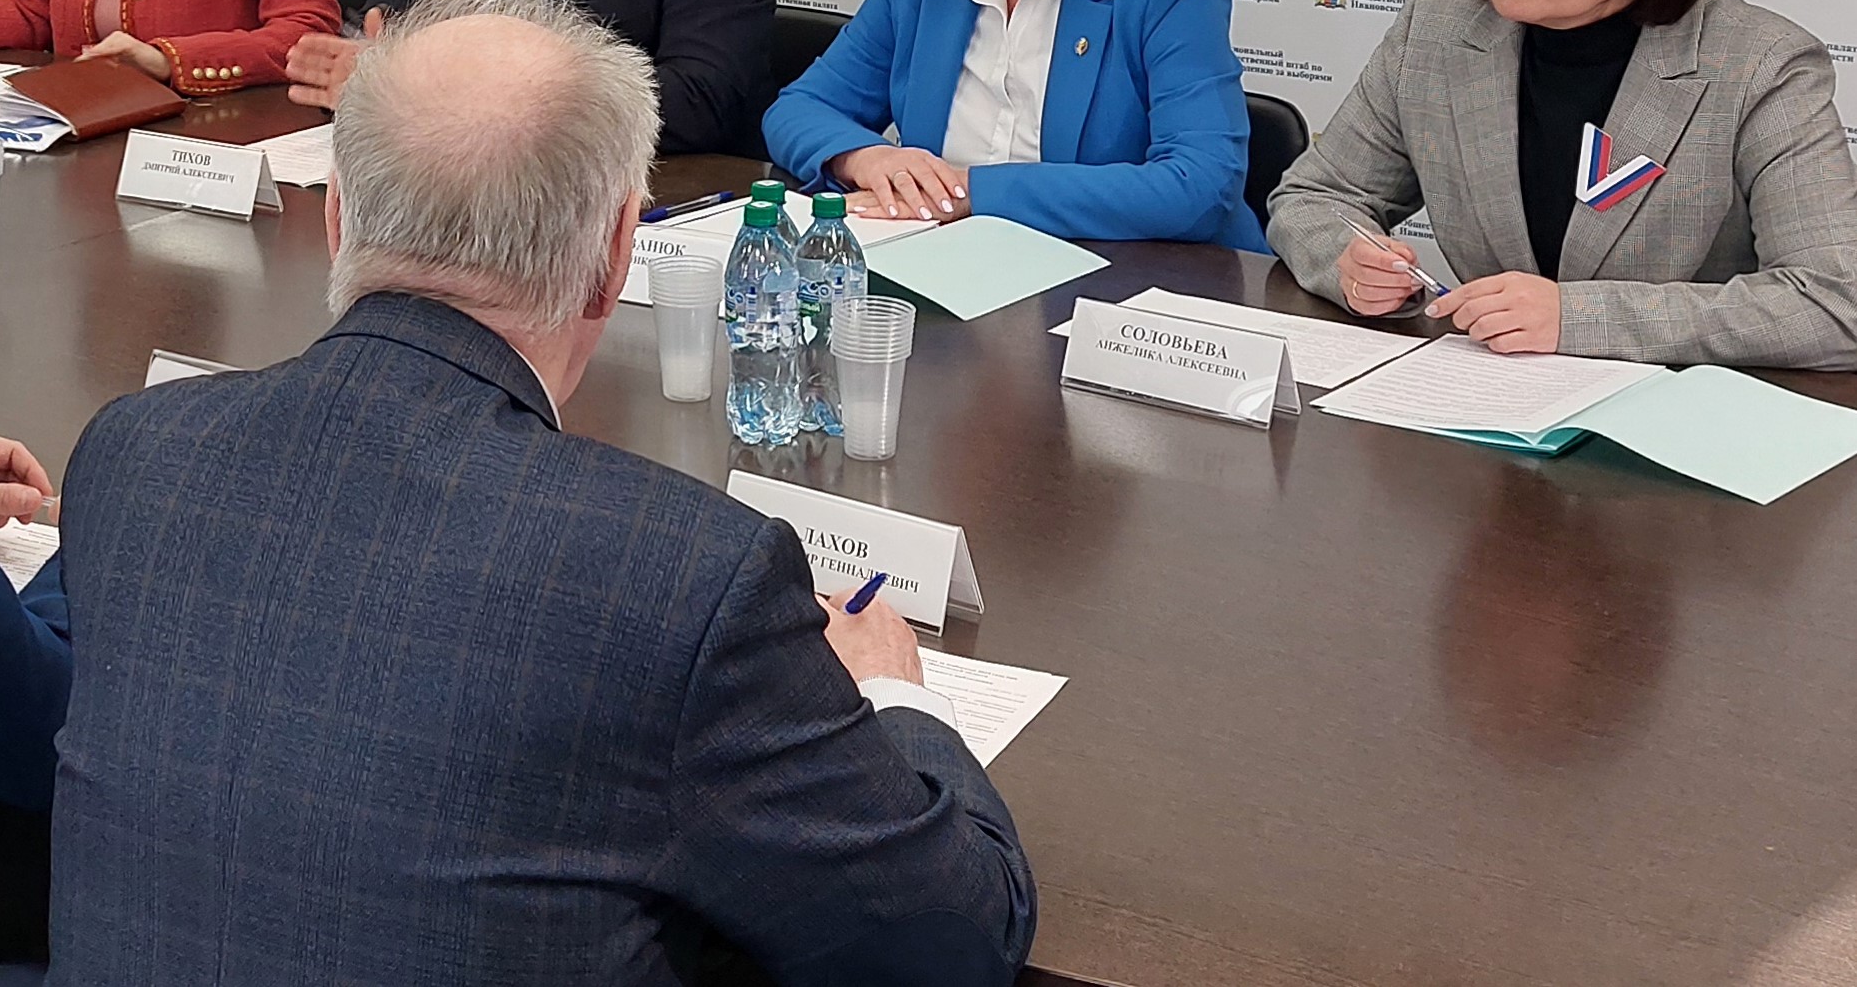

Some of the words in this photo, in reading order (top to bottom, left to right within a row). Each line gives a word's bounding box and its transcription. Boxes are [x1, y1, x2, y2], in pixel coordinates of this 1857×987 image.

[141, 162, 181, 175] ДМИТРИЙ
[182, 169, 235, 184] АЛЕКСЕЕВИЧ
[172, 150, 212, 166] ТИХОВ
[1120, 324, 1228, 360] СОЛОВЬЕВА
[1096, 339, 1163, 363] АНЖЕЛИКА
[1165, 355, 1247, 381] АЛЕКСЕЕВНА
[800, 527, 869, 559] ЛАХОВ
